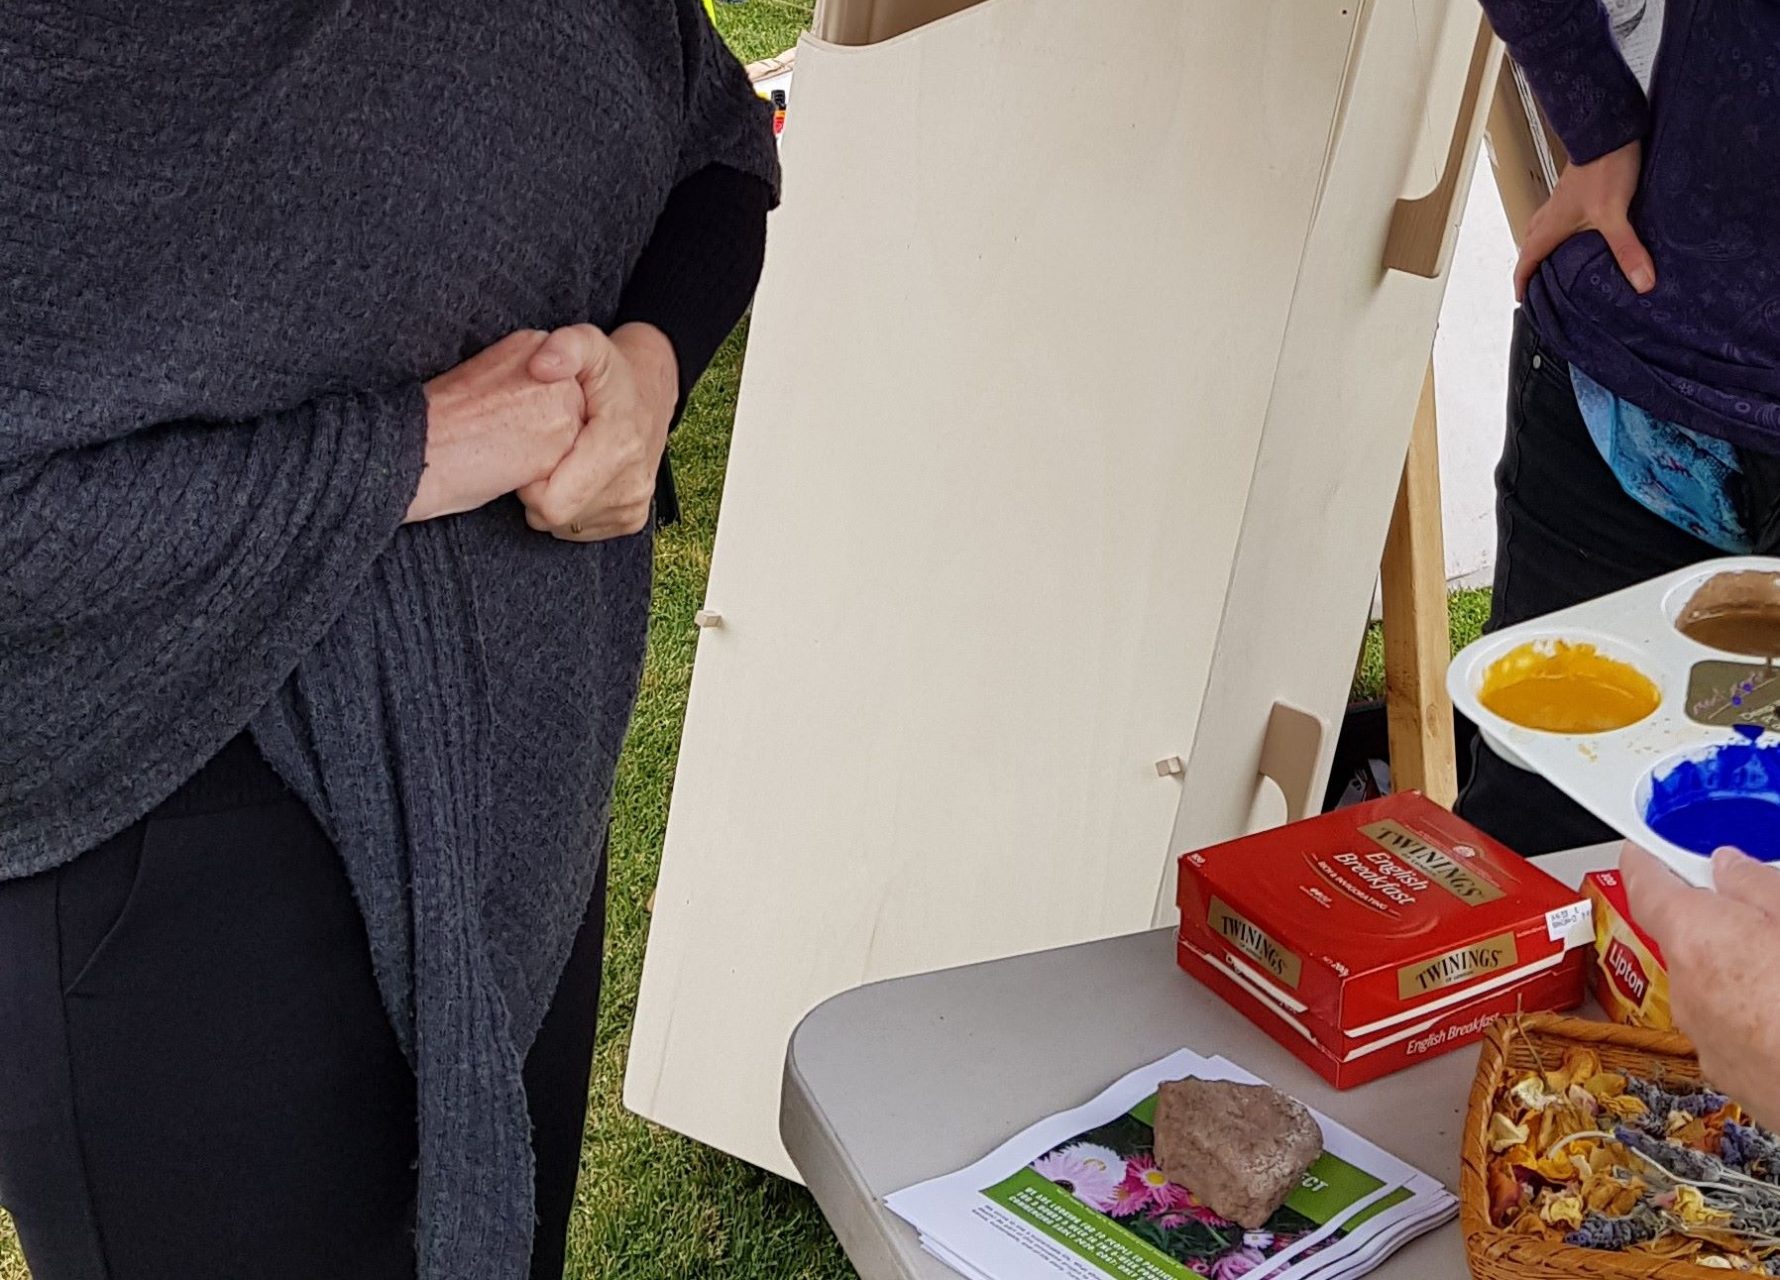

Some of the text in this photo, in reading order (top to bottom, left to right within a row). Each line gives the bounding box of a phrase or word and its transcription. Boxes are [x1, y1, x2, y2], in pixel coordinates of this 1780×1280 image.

[1332, 852, 1416, 905] Breakfast
[1365, 852, 1428, 892] English
[1375, 827, 1483, 898] TWININGS
[1220, 915, 1287, 976] TWININGS
[1415, 947, 1502, 990] TWININGS
[1608, 943, 1644, 999] Lipton
[1406, 1029, 1446, 1056] English
